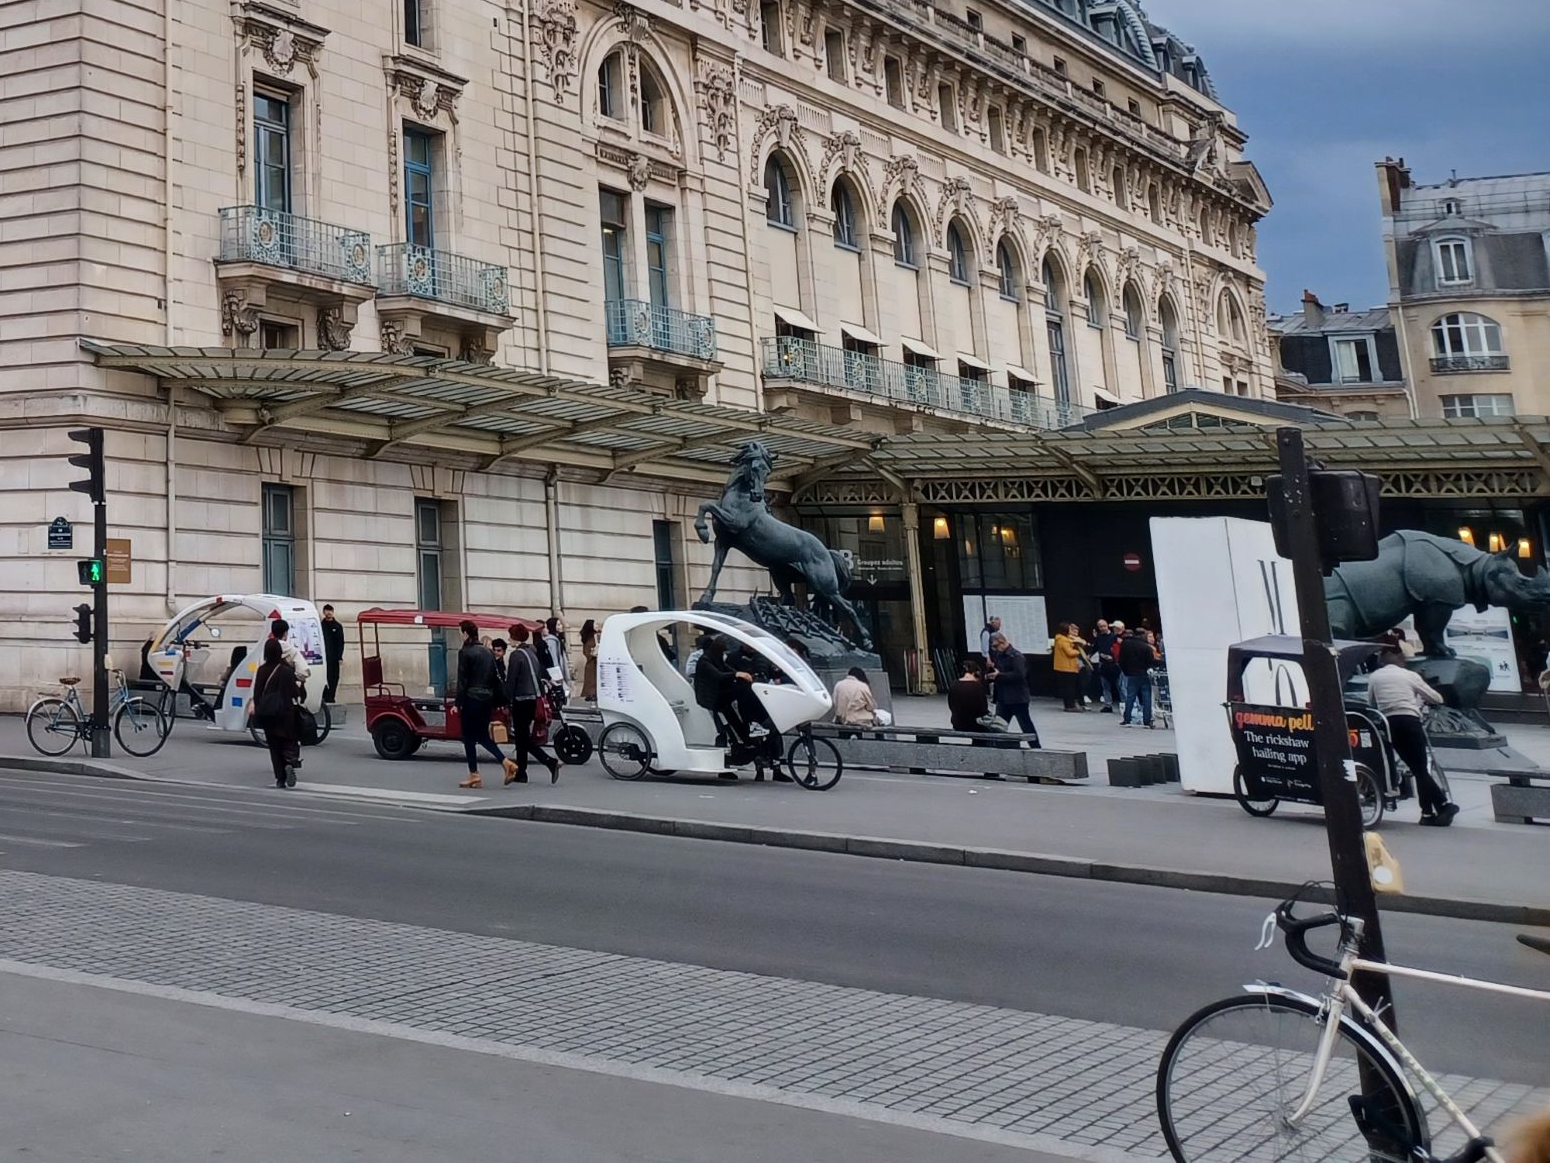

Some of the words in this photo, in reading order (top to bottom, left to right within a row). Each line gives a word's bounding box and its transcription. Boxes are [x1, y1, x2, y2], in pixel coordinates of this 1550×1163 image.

[856, 558, 881, 567] Groupes
[1235, 712, 1286, 729] gemma
[1244, 731, 1264, 744] The
[1266, 734, 1309, 748] rickshaw
[1252, 746, 1287, 763] hailing
[1288, 752, 1307, 766] app
